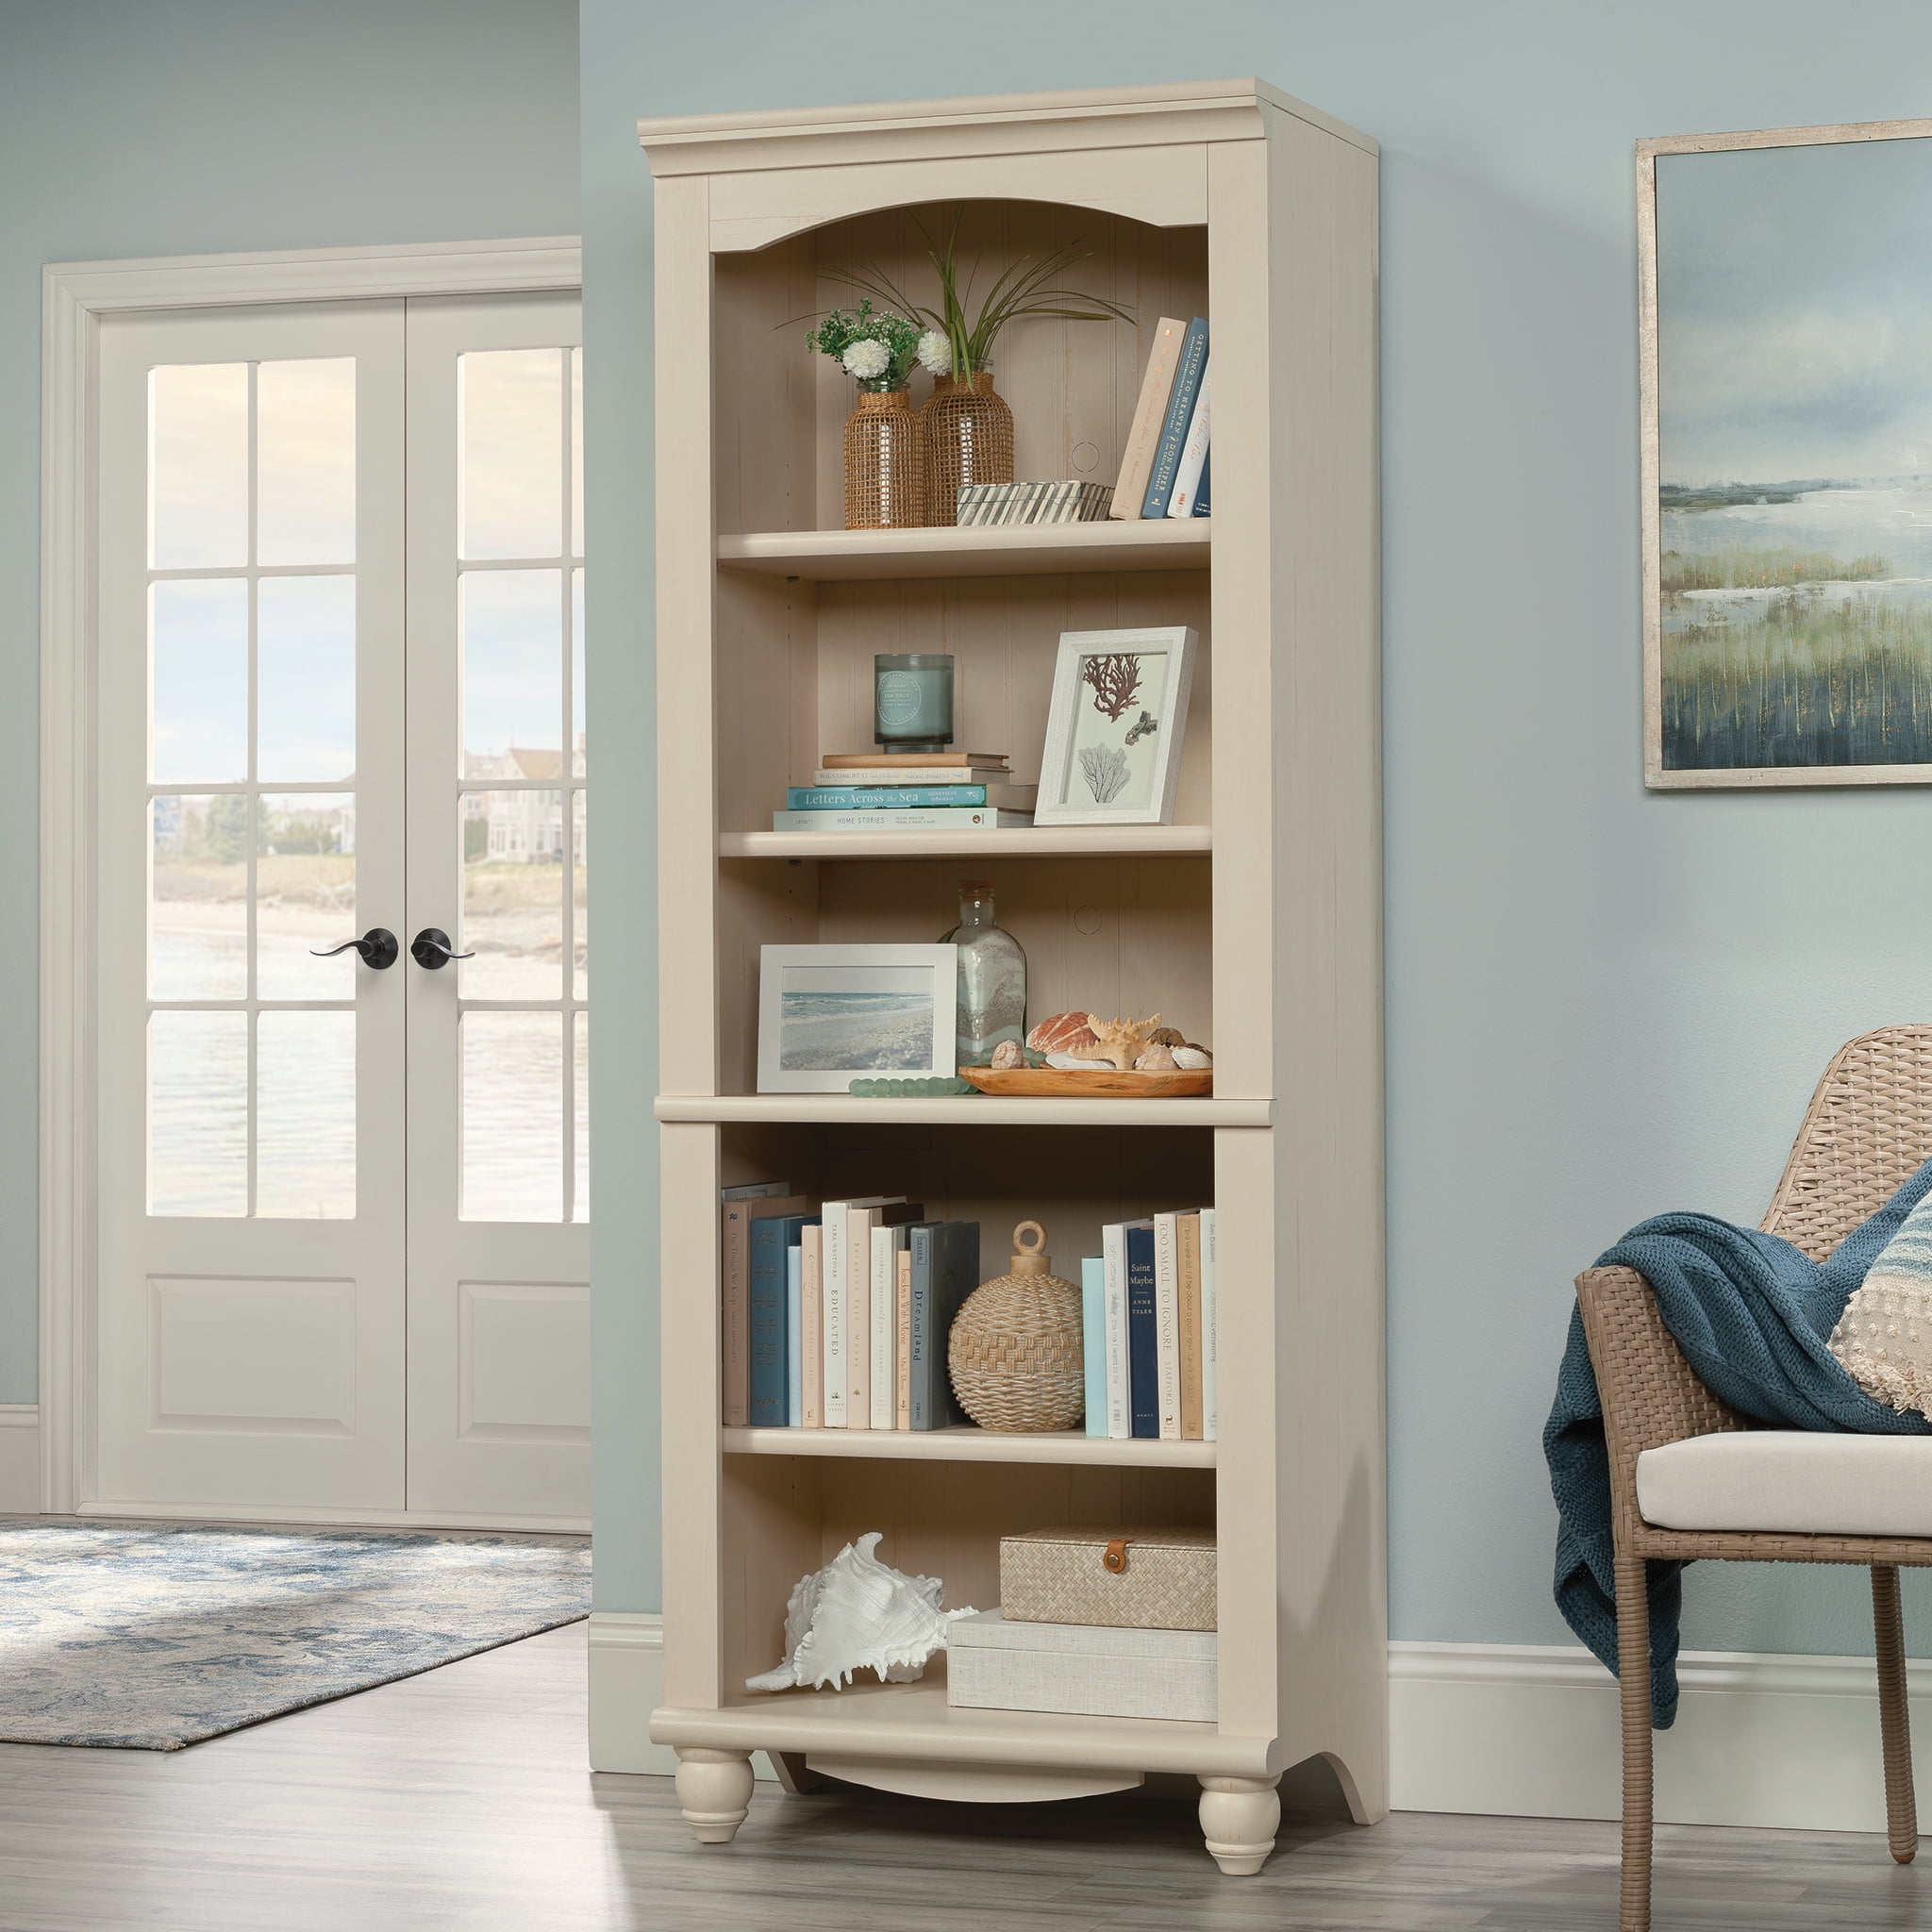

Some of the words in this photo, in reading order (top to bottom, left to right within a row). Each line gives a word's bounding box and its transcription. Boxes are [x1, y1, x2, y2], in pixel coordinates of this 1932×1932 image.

[1188, 333, 1204, 375] GETTING
[1184, 379, 1192, 391] TO
[1174, 396, 1188, 433] HEAVEN
[1165, 443, 1175, 463] DON
[1158, 465, 1170, 491] PIPER
[806, 793, 845, 805] Letters
[849, 793, 884, 803] Across
[899, 792, 919, 802] Sea
[1159, 1223, 1169, 1245] TOO
[1132, 1263, 1151, 1272] Saint
[1160, 1249, 1170, 1285] SMALL
[900, 1268, 910, 1299] Tuesdays
[1130, 1276, 1154, 1287] Maybe
[1161, 1290, 1170, 1304] TO
[900, 1300, 910, 1318] With
[1162, 1307, 1172, 1352] IGNORE
